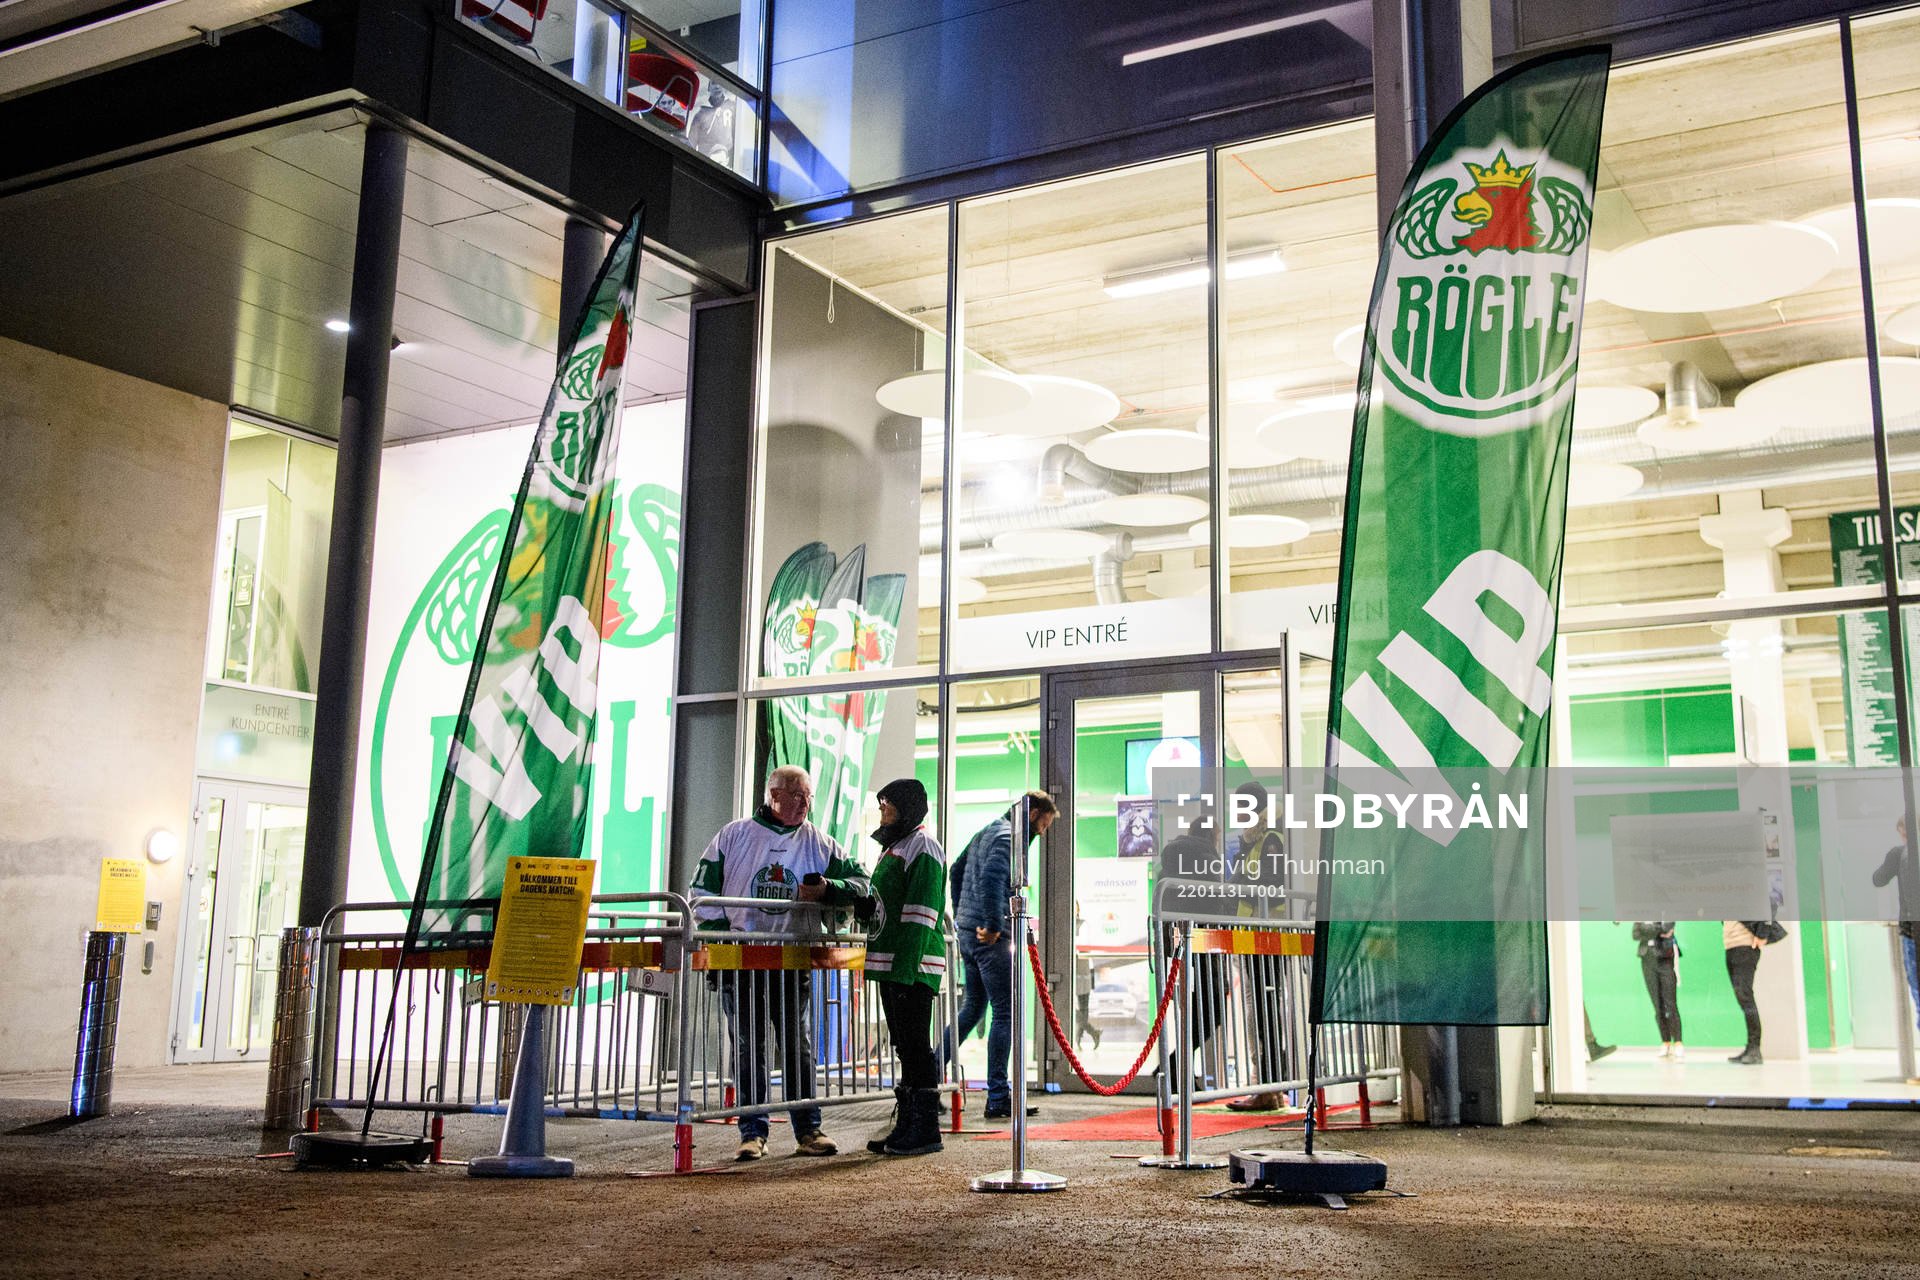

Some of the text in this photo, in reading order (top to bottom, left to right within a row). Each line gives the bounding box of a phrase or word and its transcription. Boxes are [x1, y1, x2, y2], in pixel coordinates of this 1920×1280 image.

[1391, 263, 1578, 400] RÖGLE
[1852, 512, 1920, 547] TILS
[1026, 617, 1128, 649] VIP ENTRÉ
[255, 704, 289, 720] ENTRÉ
[448, 595, 602, 822] VIP
[1326, 549, 1555, 847] VIP
[231, 716, 310, 739] KUNDCENTER
[520, 873, 578, 885] VÄLKOMMEN TILL
[520, 883, 547, 894] DAGENS
